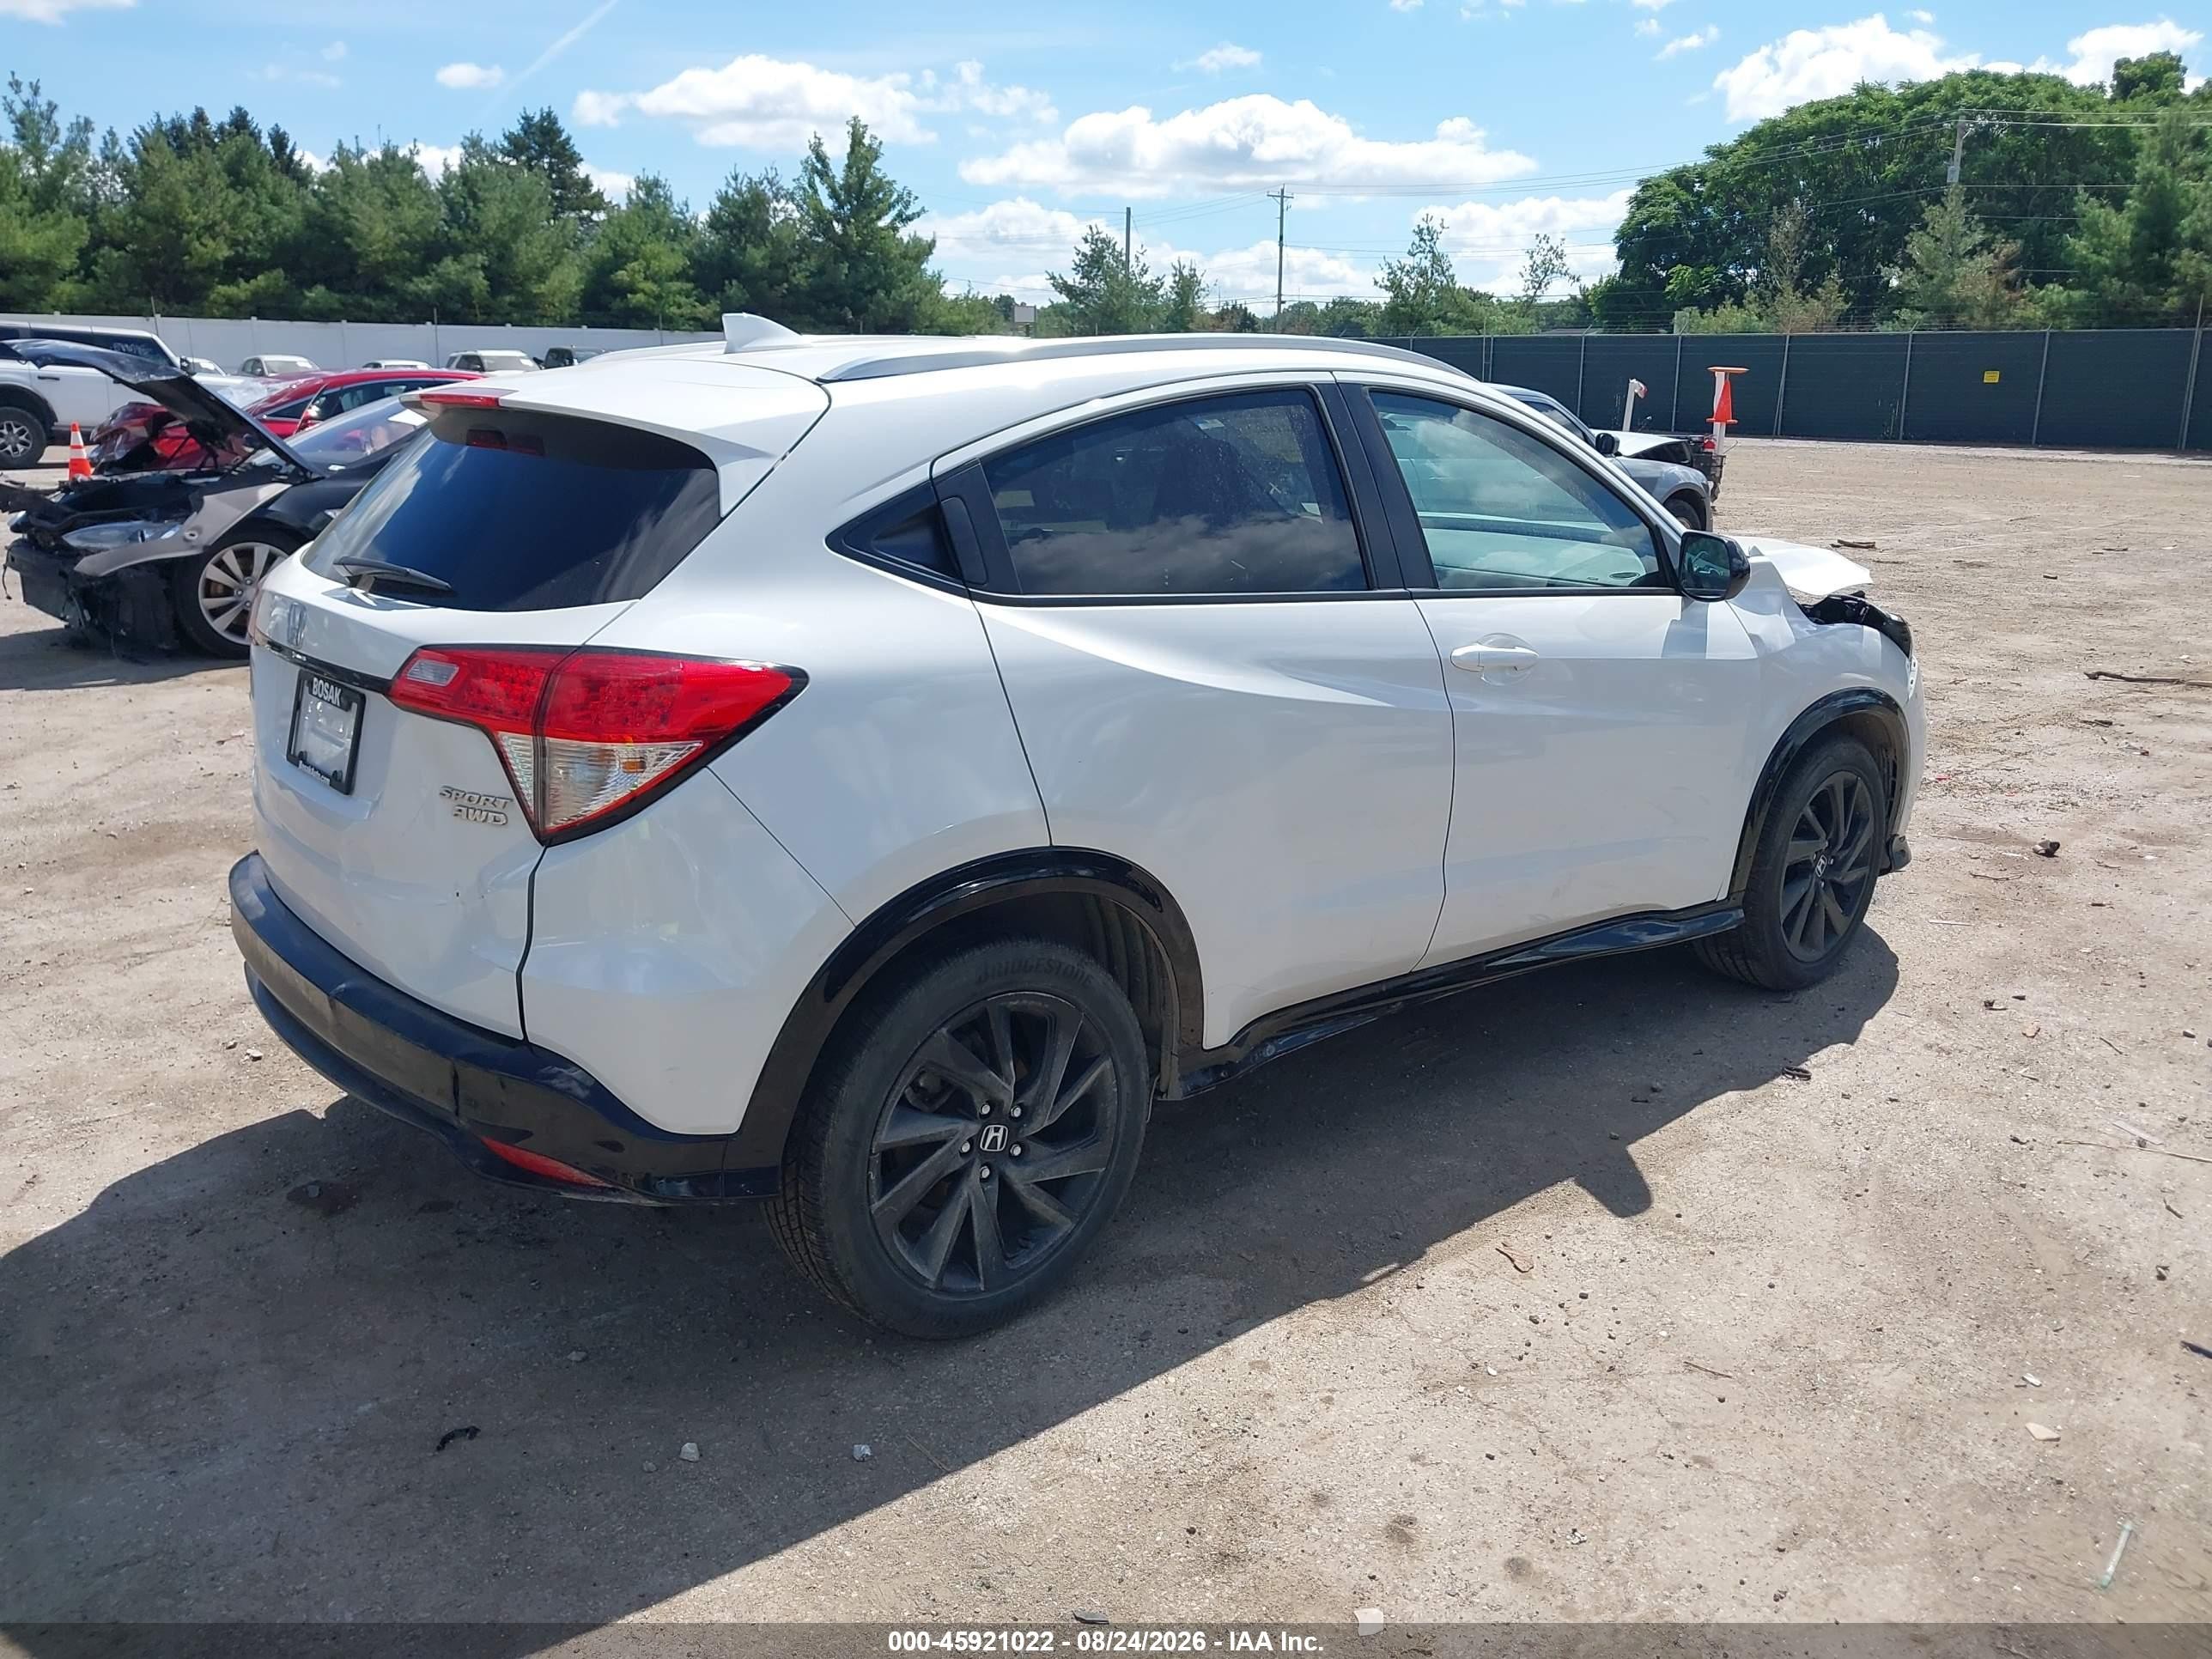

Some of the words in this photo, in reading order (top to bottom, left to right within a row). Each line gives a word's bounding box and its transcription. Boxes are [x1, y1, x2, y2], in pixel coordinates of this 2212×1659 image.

[313, 678, 341, 707] BOSAK
[439, 785, 514, 809] SPORT
[453, 805, 508, 825] AWD
